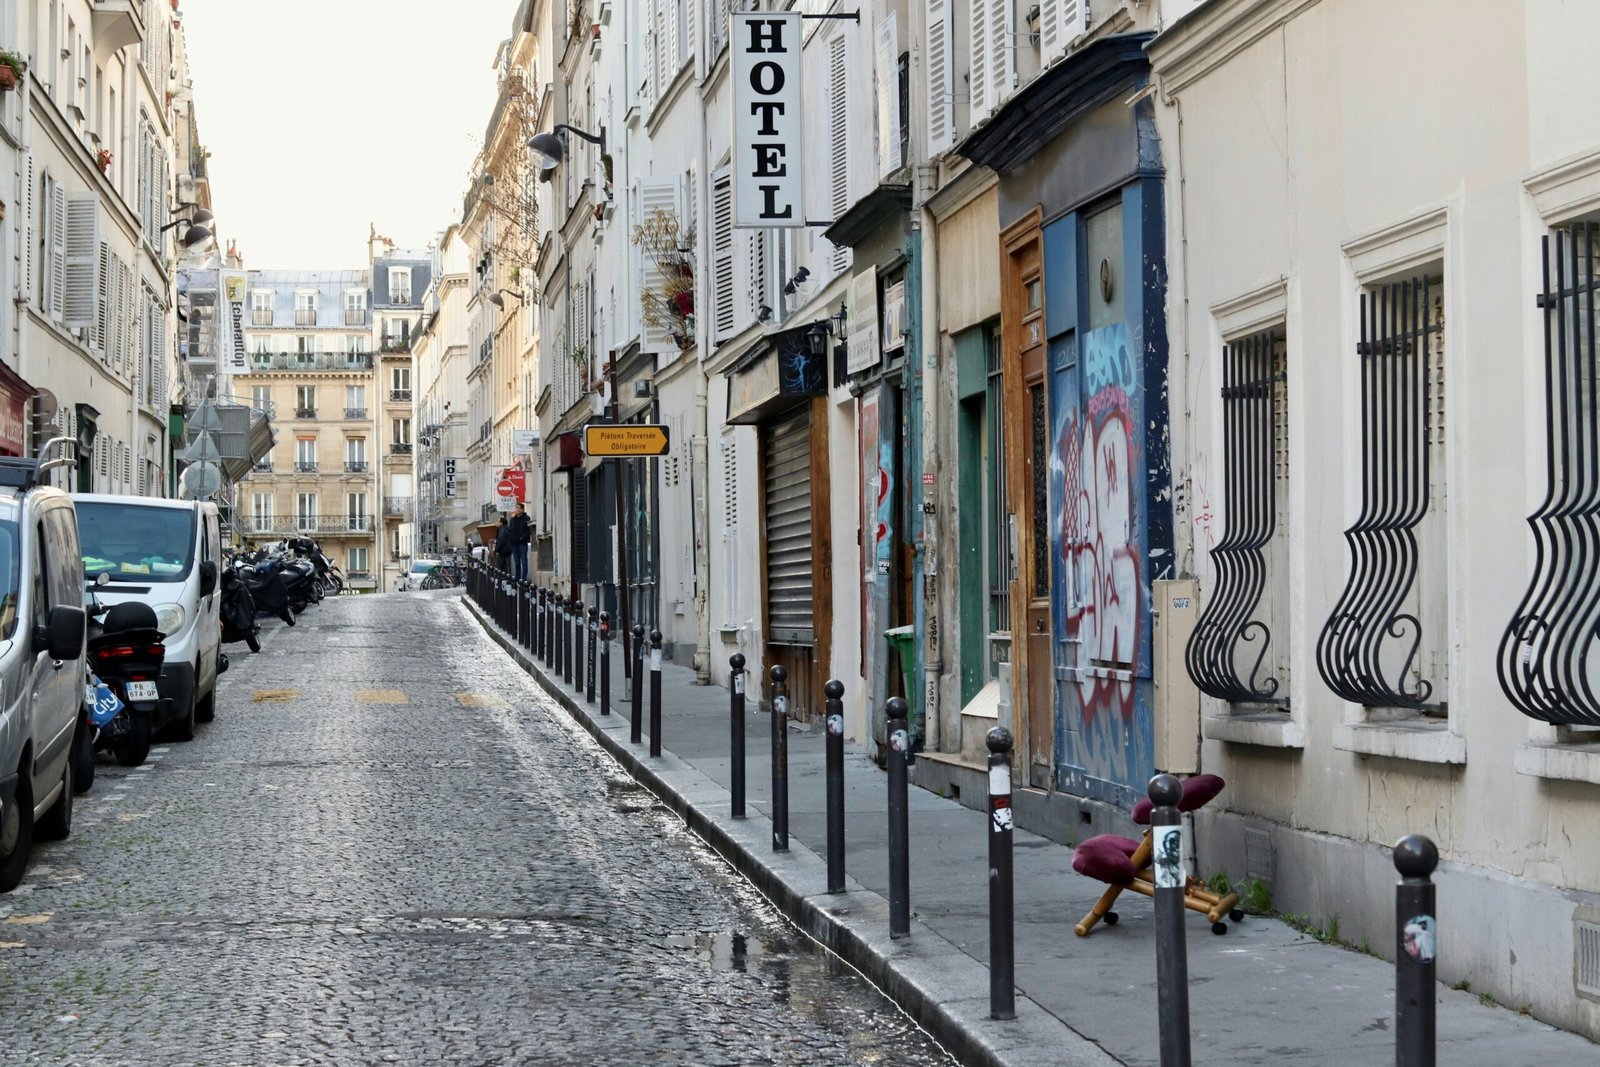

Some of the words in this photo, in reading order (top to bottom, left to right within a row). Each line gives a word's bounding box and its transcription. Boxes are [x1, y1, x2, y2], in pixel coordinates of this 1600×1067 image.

[745, 19, 792, 219] HOTEL
[230, 301, 245, 367] Echafautop
[611, 443, 646, 451] Obligatoire
[627, 431, 656, 439] Traversée
[446, 459, 455, 496] HOTEL
